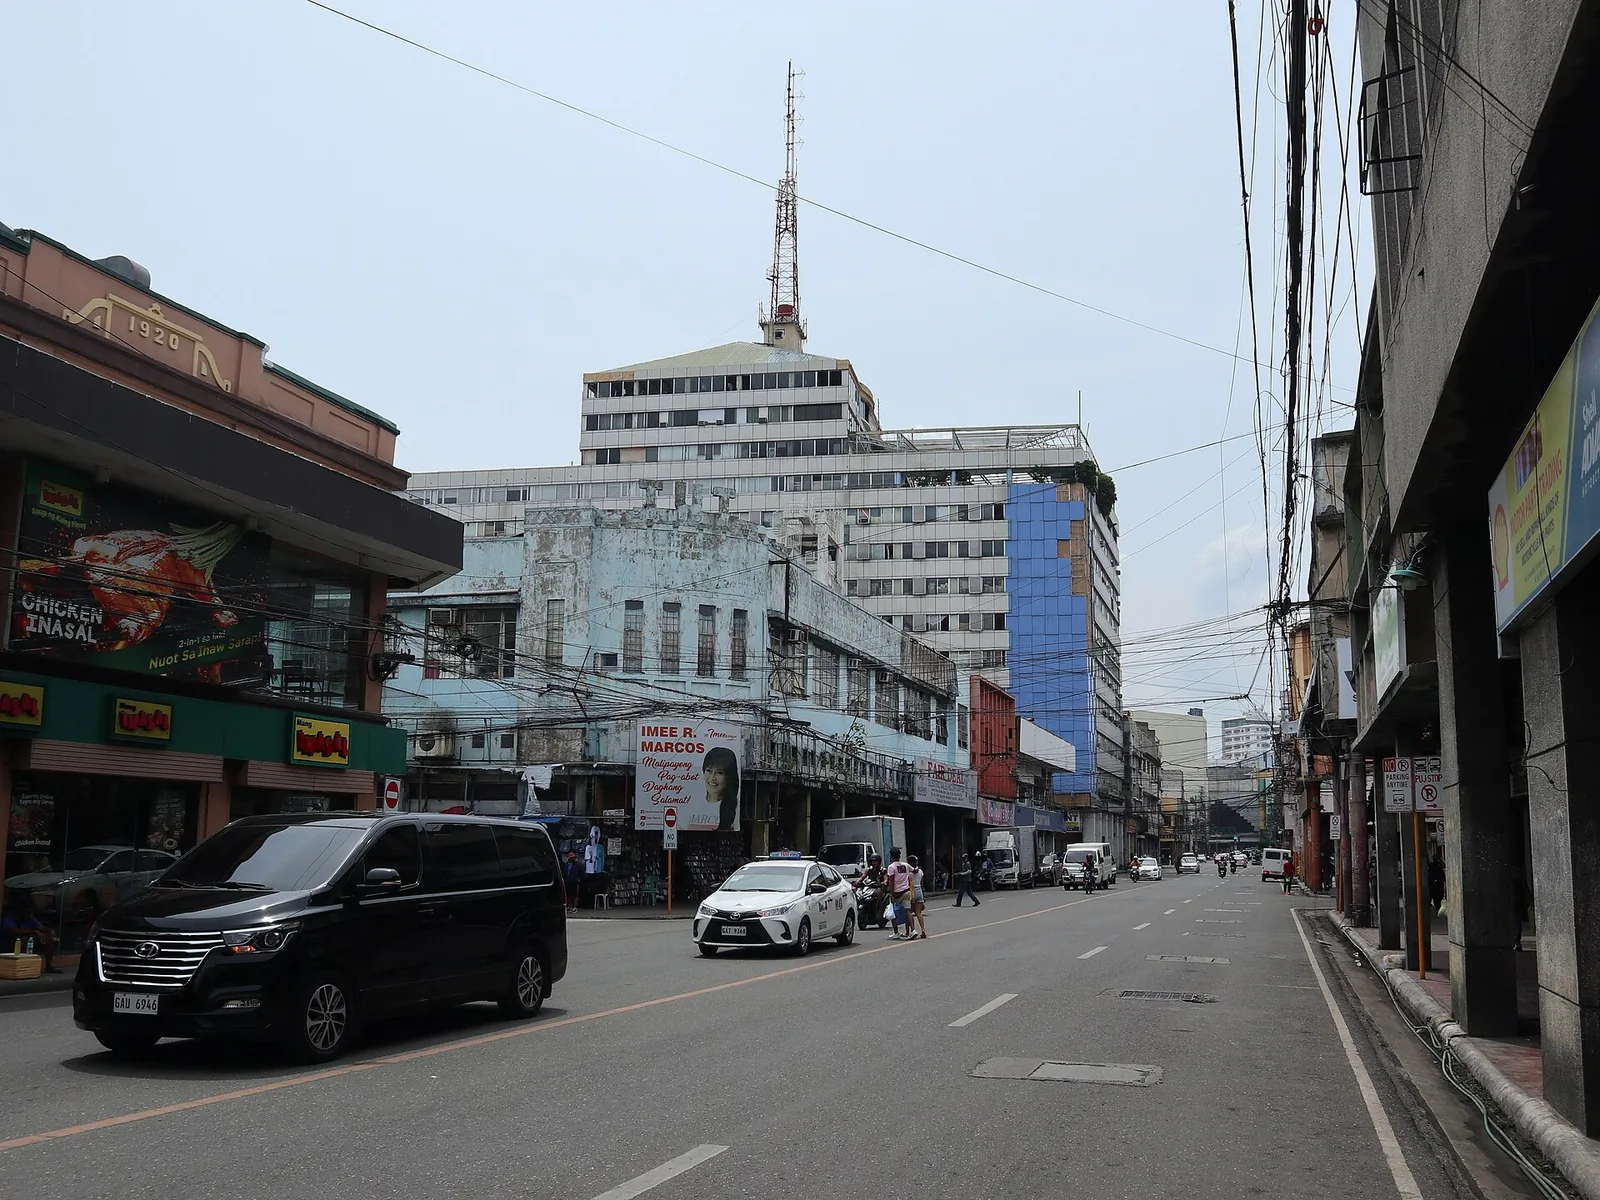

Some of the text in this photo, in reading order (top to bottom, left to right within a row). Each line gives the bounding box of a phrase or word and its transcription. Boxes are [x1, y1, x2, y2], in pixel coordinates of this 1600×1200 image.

[128, 315, 180, 350] 1920
[1582, 389, 1597, 431] Shell
[22, 592, 103, 625] CHICKEN
[25, 613, 97, 644] INASAL
[179, 636, 200, 648] 2-in-1
[149, 652, 179, 670] Nuot
[182, 649, 196, 661] Sa
[198, 643, 225, 657] Ihaw
[296, 719, 313, 729] Mang
[641, 725, 697, 738] IMEE R.
[641, 741, 705, 754] MARCOS
[642, 756, 694, 771] Malipayong
[1384, 760, 1395, 772] NO
[657, 770, 700, 783] Pag-abot
[1415, 773, 1443, 783] PUJ STOP
[642, 780, 685, 794] Daghang
[1387, 780, 1408, 788] ANYTIME
[651, 793, 692, 806] Salamat!
[667, 833, 676, 841] NO
[114, 998, 157, 1011] GAU 6946
